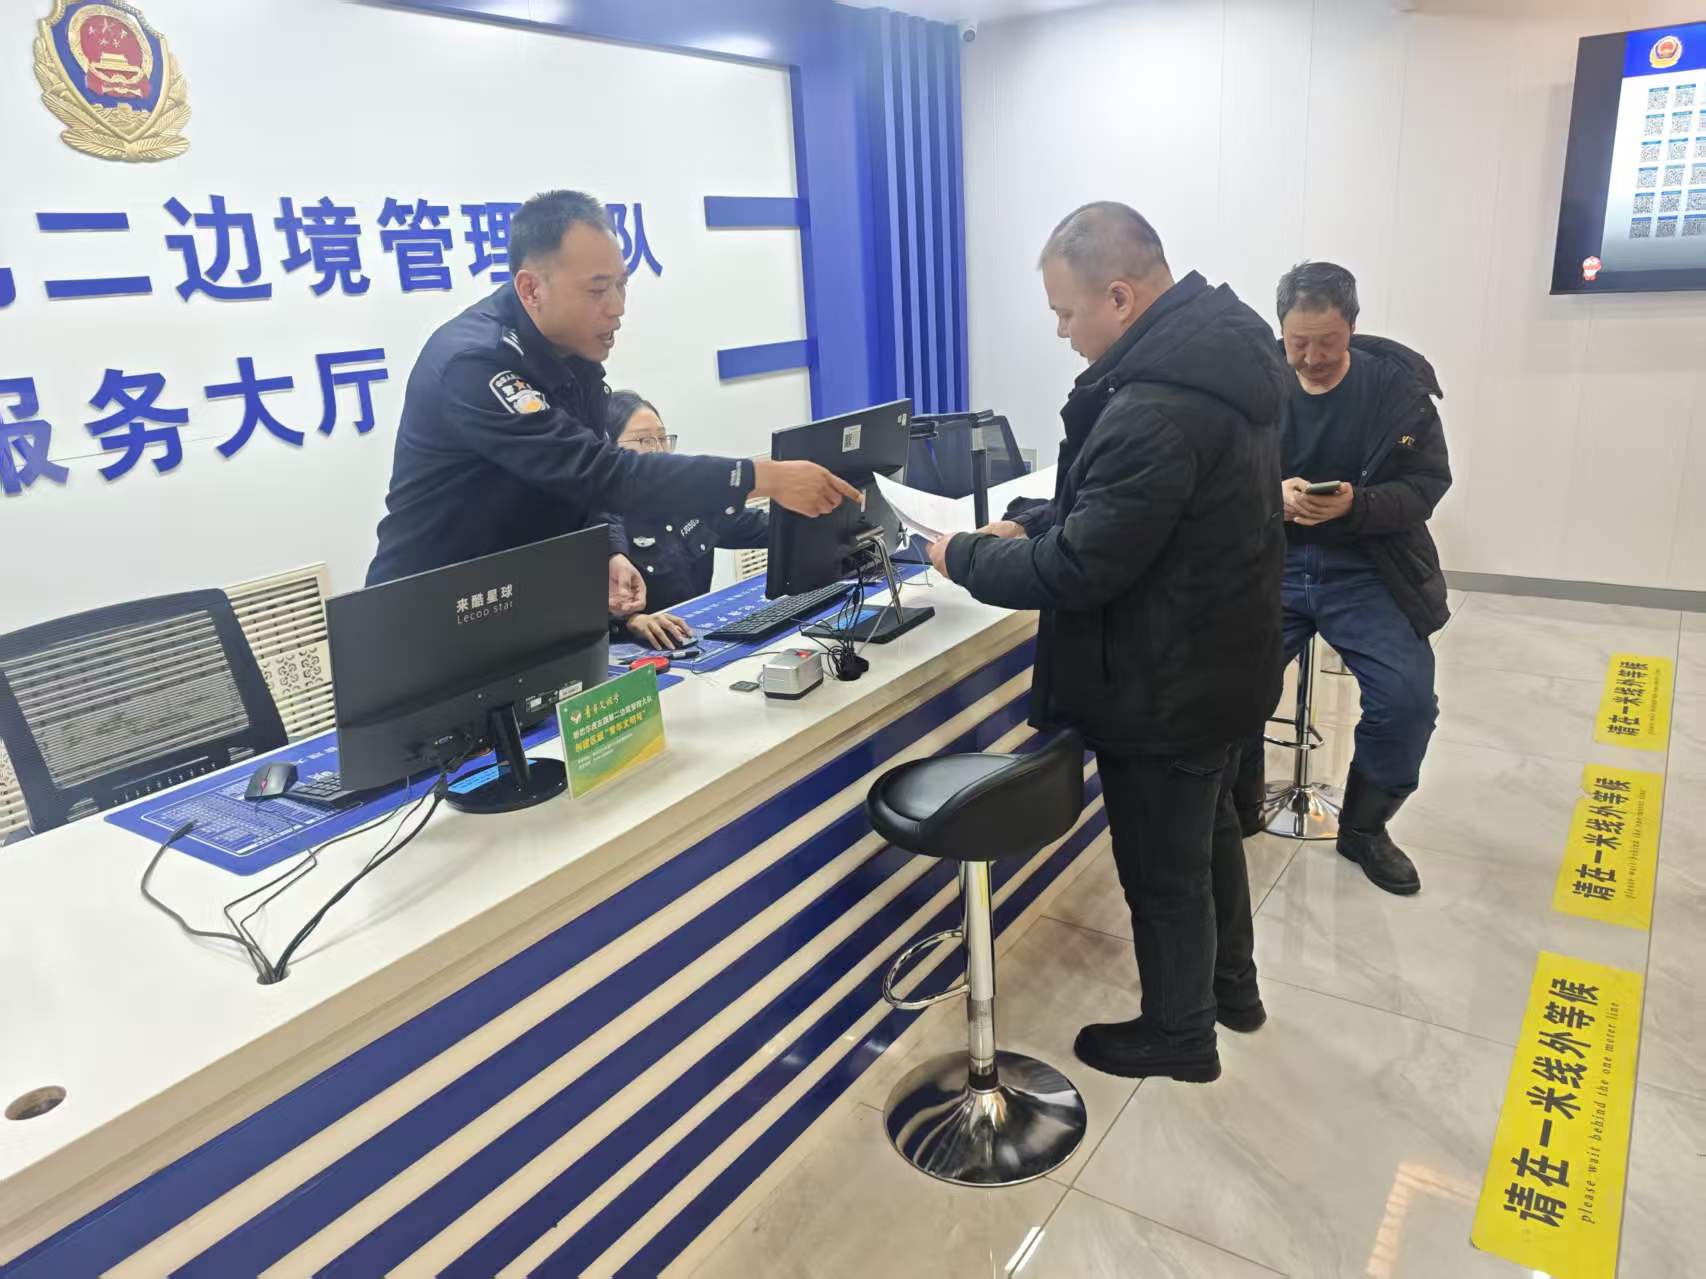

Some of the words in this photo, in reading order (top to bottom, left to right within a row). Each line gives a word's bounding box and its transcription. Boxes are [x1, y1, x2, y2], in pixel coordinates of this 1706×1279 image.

[0, 195, 663, 309] 二边境管理队
[456, 584, 513, 613] 来酷星球
[457, 608, 490, 625] Lecoo
[1607, 661, 1648, 737] 请在一米线外等候
[1572, 777, 1632, 901] 请在一米线外等候
[1606, 1002, 1620, 1020] line
[1604, 1023, 1617, 1052] meter
[1602, 1056, 1612, 1074] one
[1503, 978, 1600, 1227] 请在一米线外等候
[1596, 1079, 1609, 1097] the
[1588, 1101, 1606, 1141] behind
[1586, 1147, 1600, 1173] wait
[1578, 1180, 1596, 1225] please
